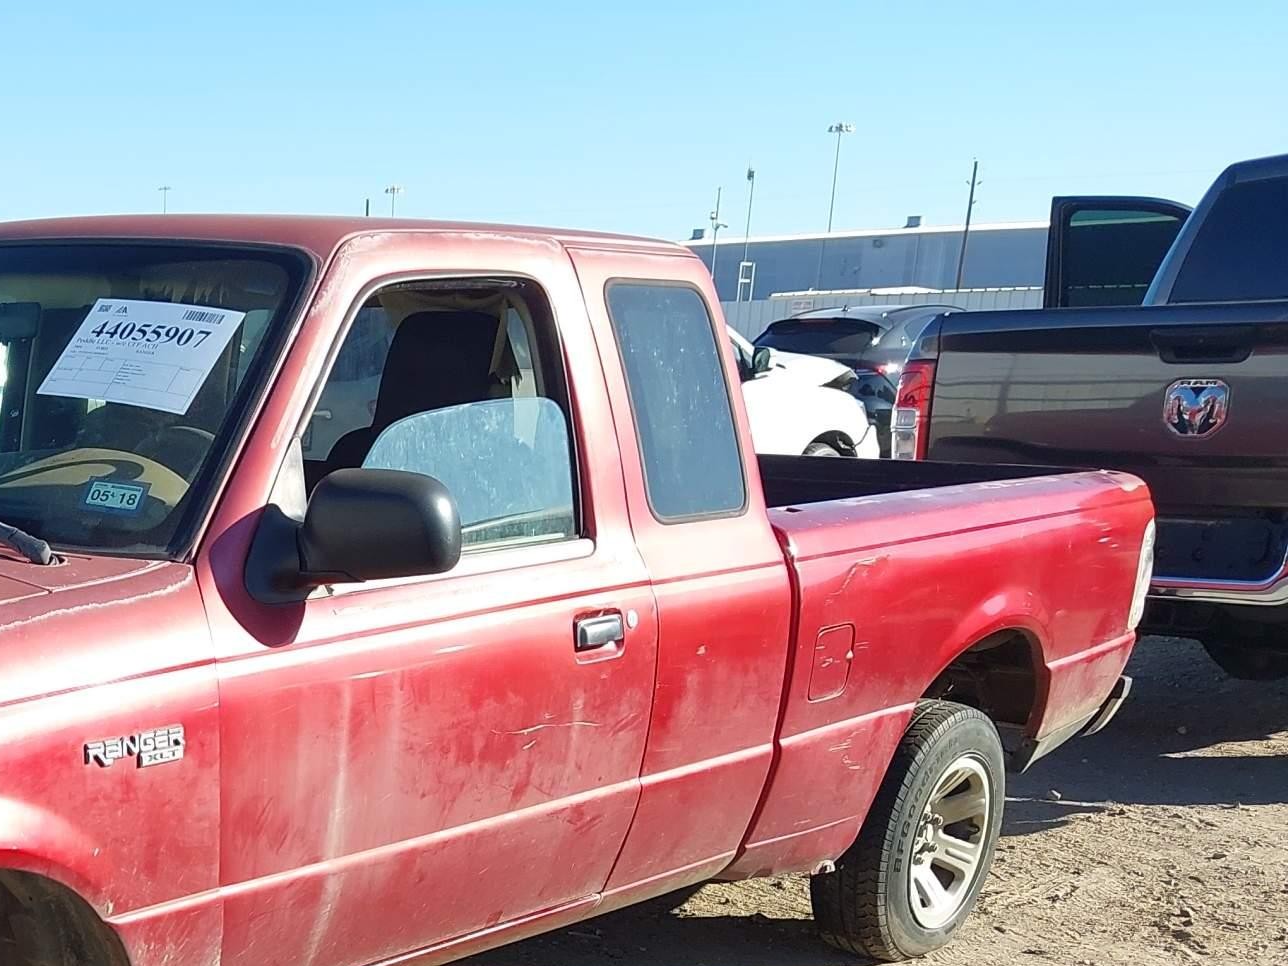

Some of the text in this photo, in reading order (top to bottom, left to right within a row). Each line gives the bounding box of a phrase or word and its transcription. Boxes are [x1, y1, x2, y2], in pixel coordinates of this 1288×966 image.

[91, 319, 212, 349] 44055907
[90, 489, 138, 506] 05 18
[84, 725, 186, 768] RANGER
[146, 749, 180, 763] XLT
